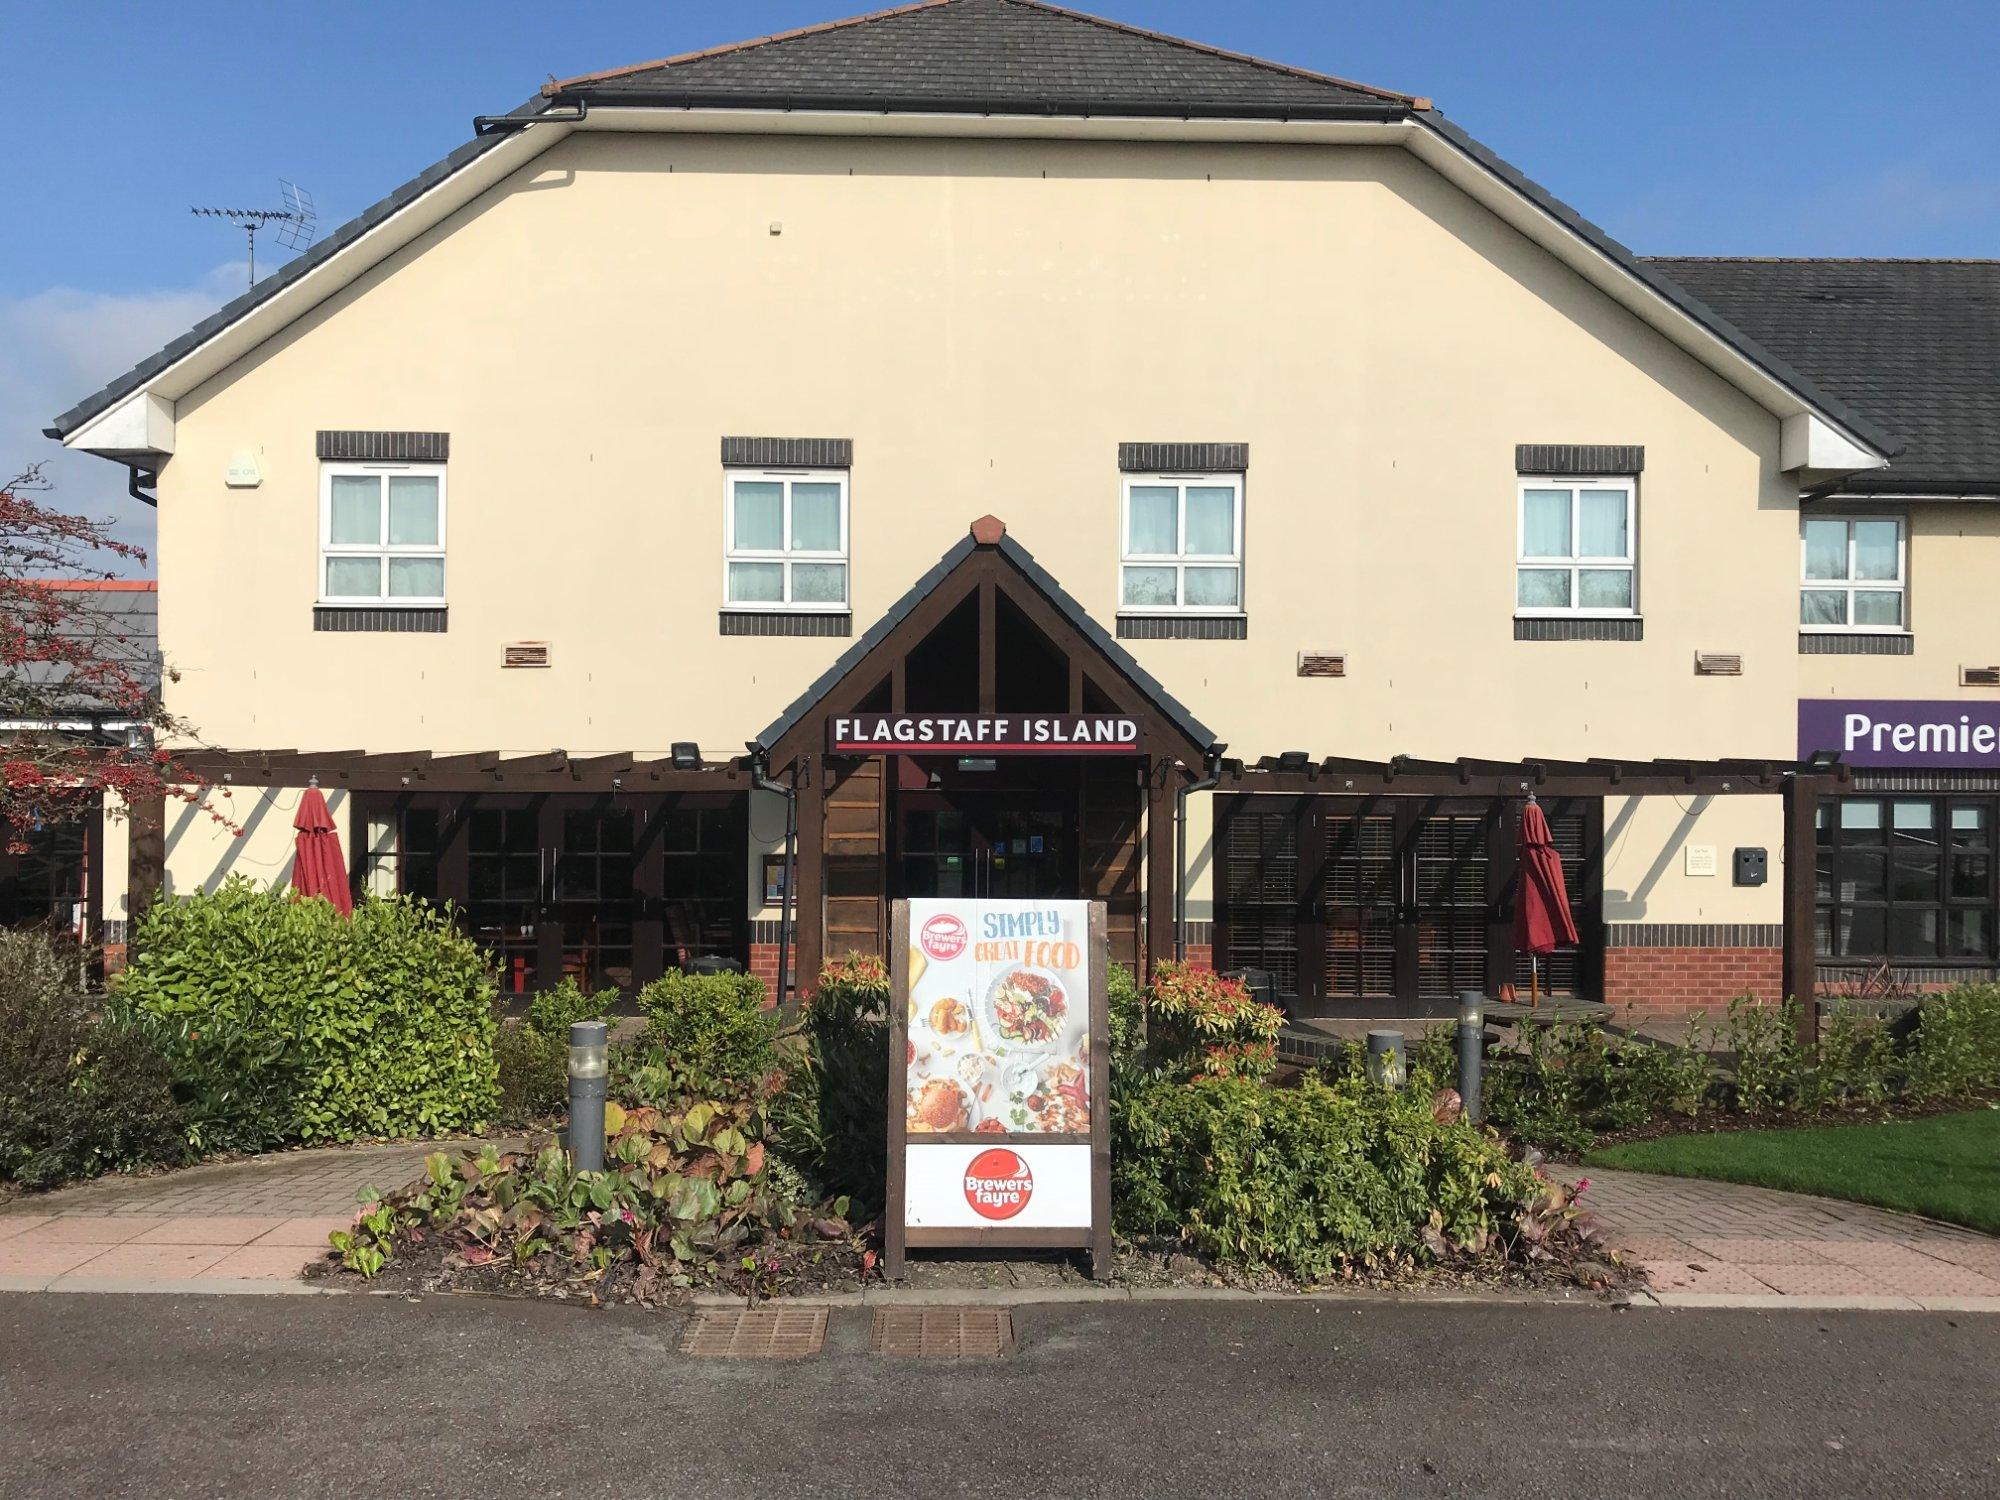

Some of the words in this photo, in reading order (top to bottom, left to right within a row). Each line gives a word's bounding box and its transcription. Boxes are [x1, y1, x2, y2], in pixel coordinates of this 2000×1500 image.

[835, 718, 1009, 742] FLAGSTAFF
[1023, 719, 1138, 742] ISLAND
[1844, 713, 2000, 754] Premie
[983, 910, 1060, 939] SIMPLY
[923, 930, 966, 945] Brewers
[928, 940, 958, 953] fayre
[974, 940, 1020, 962] GREAT
[1024, 939, 1081, 970] FOOD
[965, 1176, 1032, 1192] Brewers
[975, 1188, 1020, 1208] fayre
